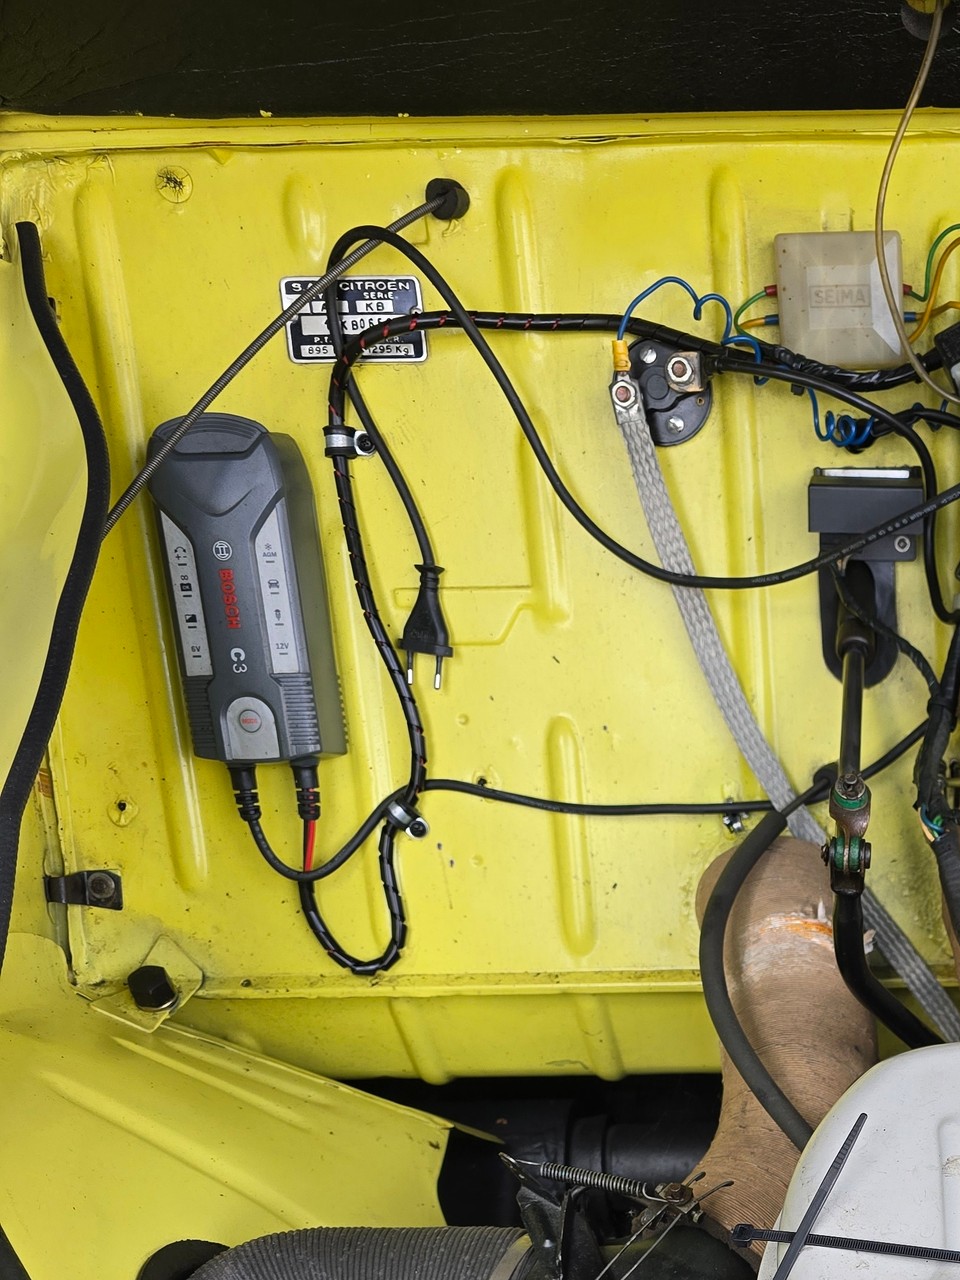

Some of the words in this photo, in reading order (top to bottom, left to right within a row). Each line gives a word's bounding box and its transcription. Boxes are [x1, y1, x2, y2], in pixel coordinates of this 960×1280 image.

[339, 282, 410, 291] CITROEN
[814, 289, 866, 304] SEIMA
[365, 302, 385, 311] KB
[308, 346, 329, 355] 895
[368, 345, 393, 354] 1295
[395, 346, 409, 357] Kg
[219, 569, 240, 628] BOSCH
[230, 647, 248, 675] C3
